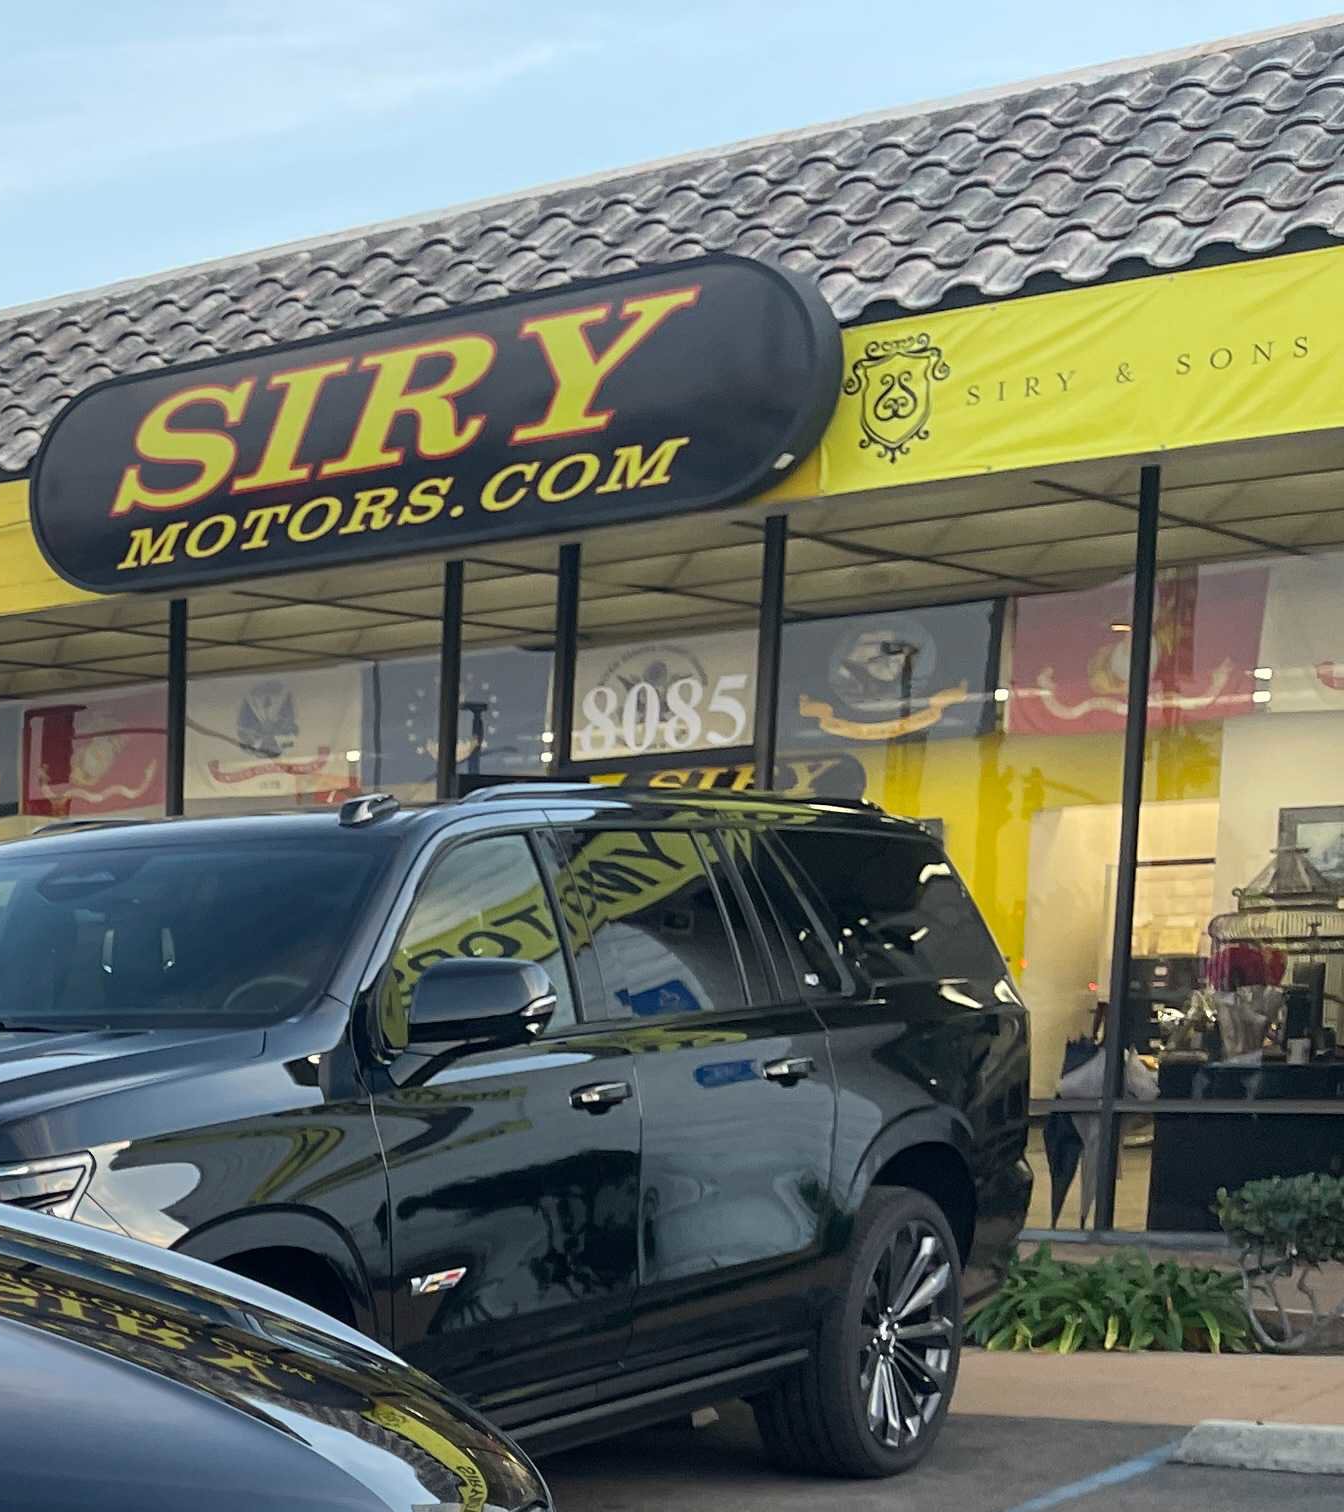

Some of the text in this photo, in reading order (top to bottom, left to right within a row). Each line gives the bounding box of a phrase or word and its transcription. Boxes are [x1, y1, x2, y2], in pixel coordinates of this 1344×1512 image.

[110, 285, 702, 517] SIRY
[966, 335, 1311, 407] SIRY & SONS
[116, 436, 690, 571] MOTORS.COM
[580, 673, 749, 757] 8085
